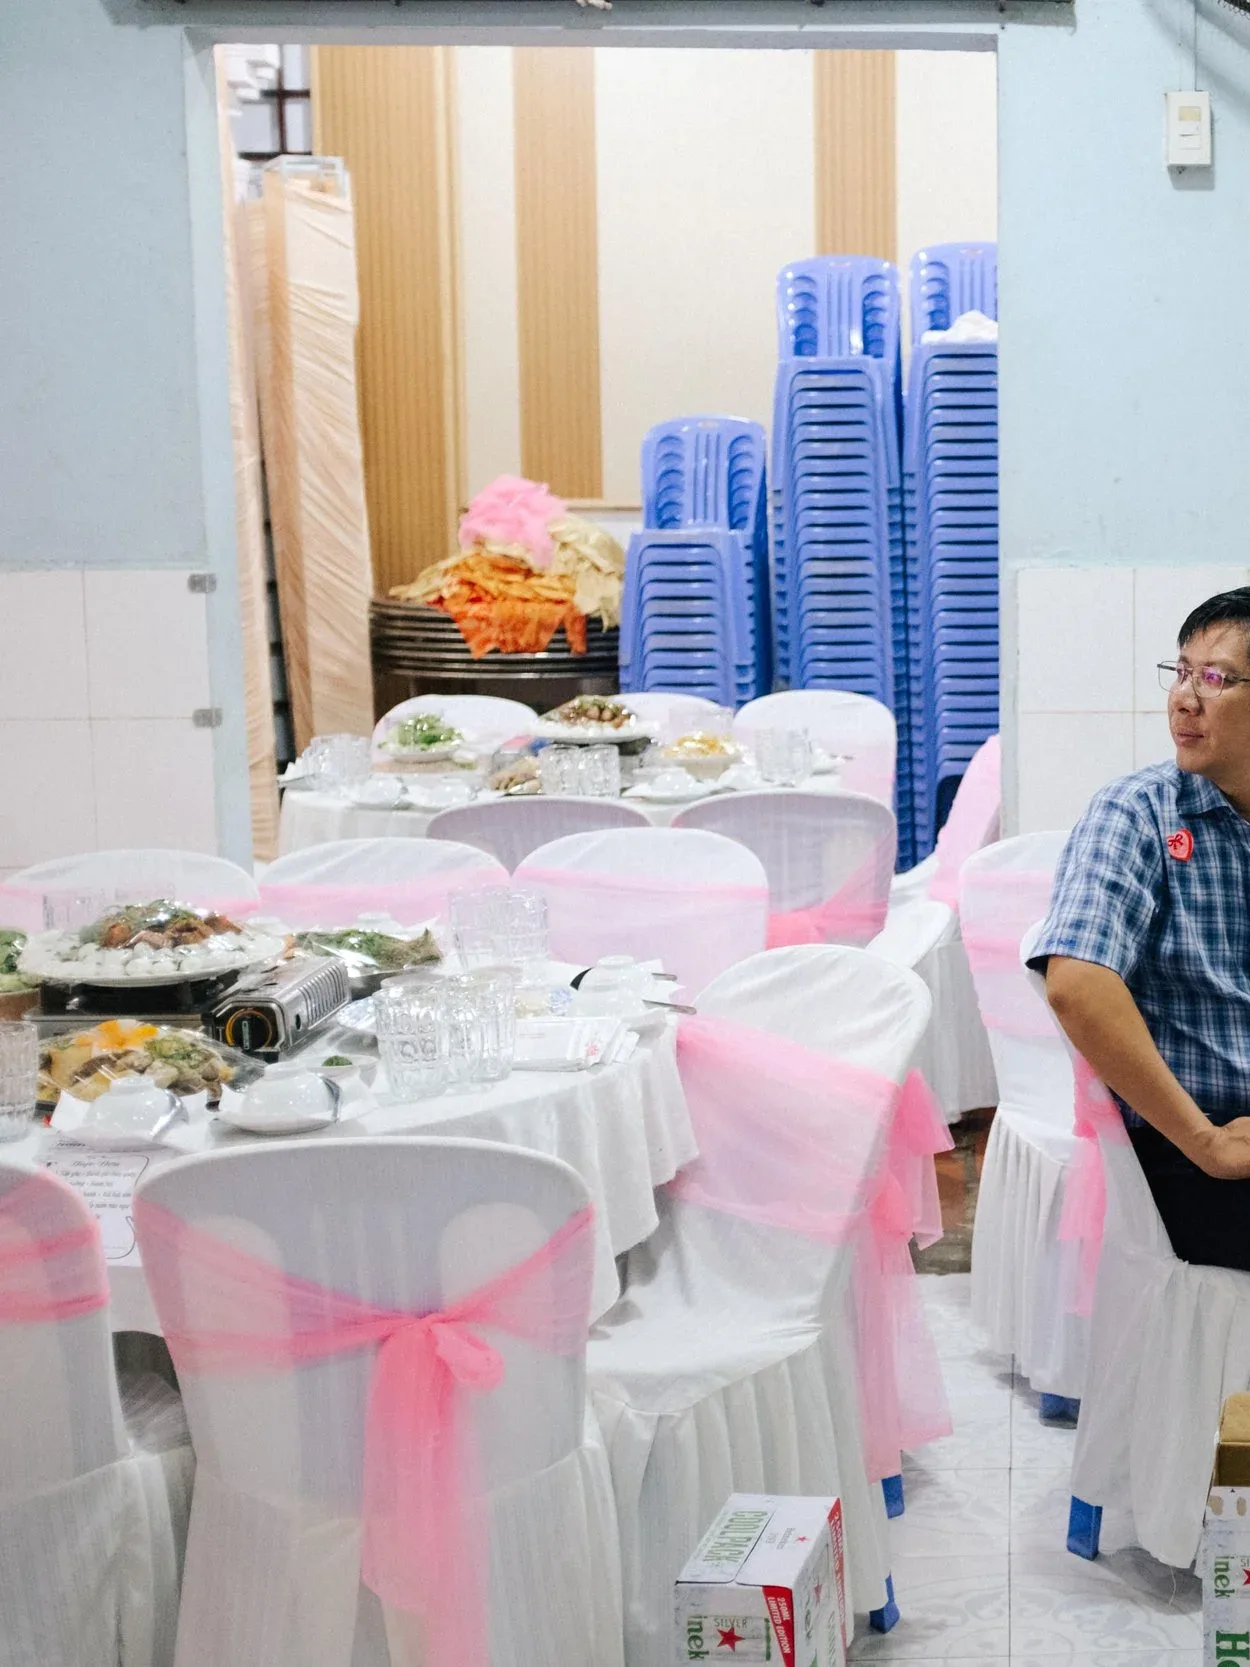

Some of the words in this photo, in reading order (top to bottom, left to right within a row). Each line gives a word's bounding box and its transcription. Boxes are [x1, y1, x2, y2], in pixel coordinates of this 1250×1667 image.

[776, 1596, 792, 1621] 250ML
[713, 1617, 748, 1629] SILVER
[767, 1596, 783, 1625] LIMITED
[775, 1625, 792, 1654] EDITION
